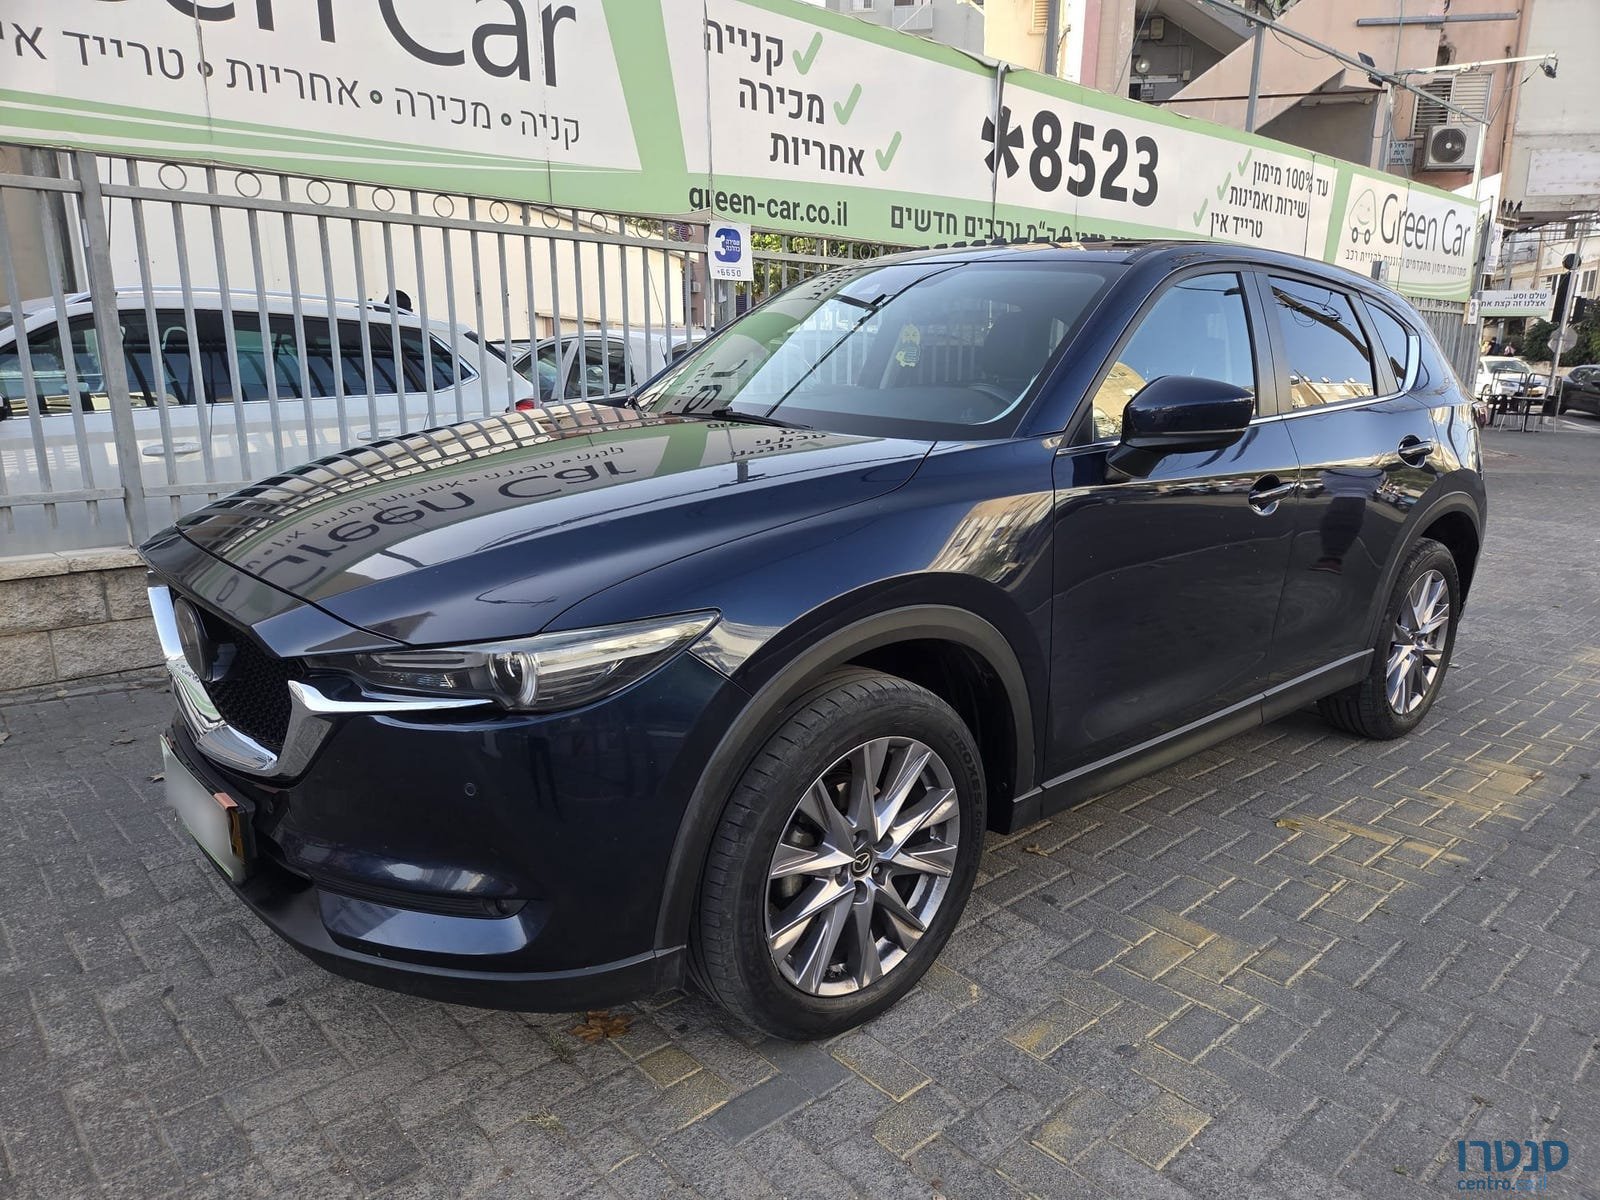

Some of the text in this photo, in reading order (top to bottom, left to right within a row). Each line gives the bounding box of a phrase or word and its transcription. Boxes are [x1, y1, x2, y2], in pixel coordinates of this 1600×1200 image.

[62, 29, 186, 80] טרייד
[703, 18, 784, 76] קנייה
[225, 57, 361, 109] אחריות
[738, 77, 825, 125] מכירה
[394, 86, 492, 130] מכירה
[520, 109, 580, 151] קניה
[769, 132, 865, 177] אחריות
[1252, 161, 1329, 197] עד 100% מימון
[689, 186, 849, 228] green-car.co.il
[891, 205, 958, 237] חדשים
[1228, 185, 1308, 219] שירות ואמינות
[1209, 212, 1264, 239] טרייד אין
[1380, 193, 1471, 258] Green Car
